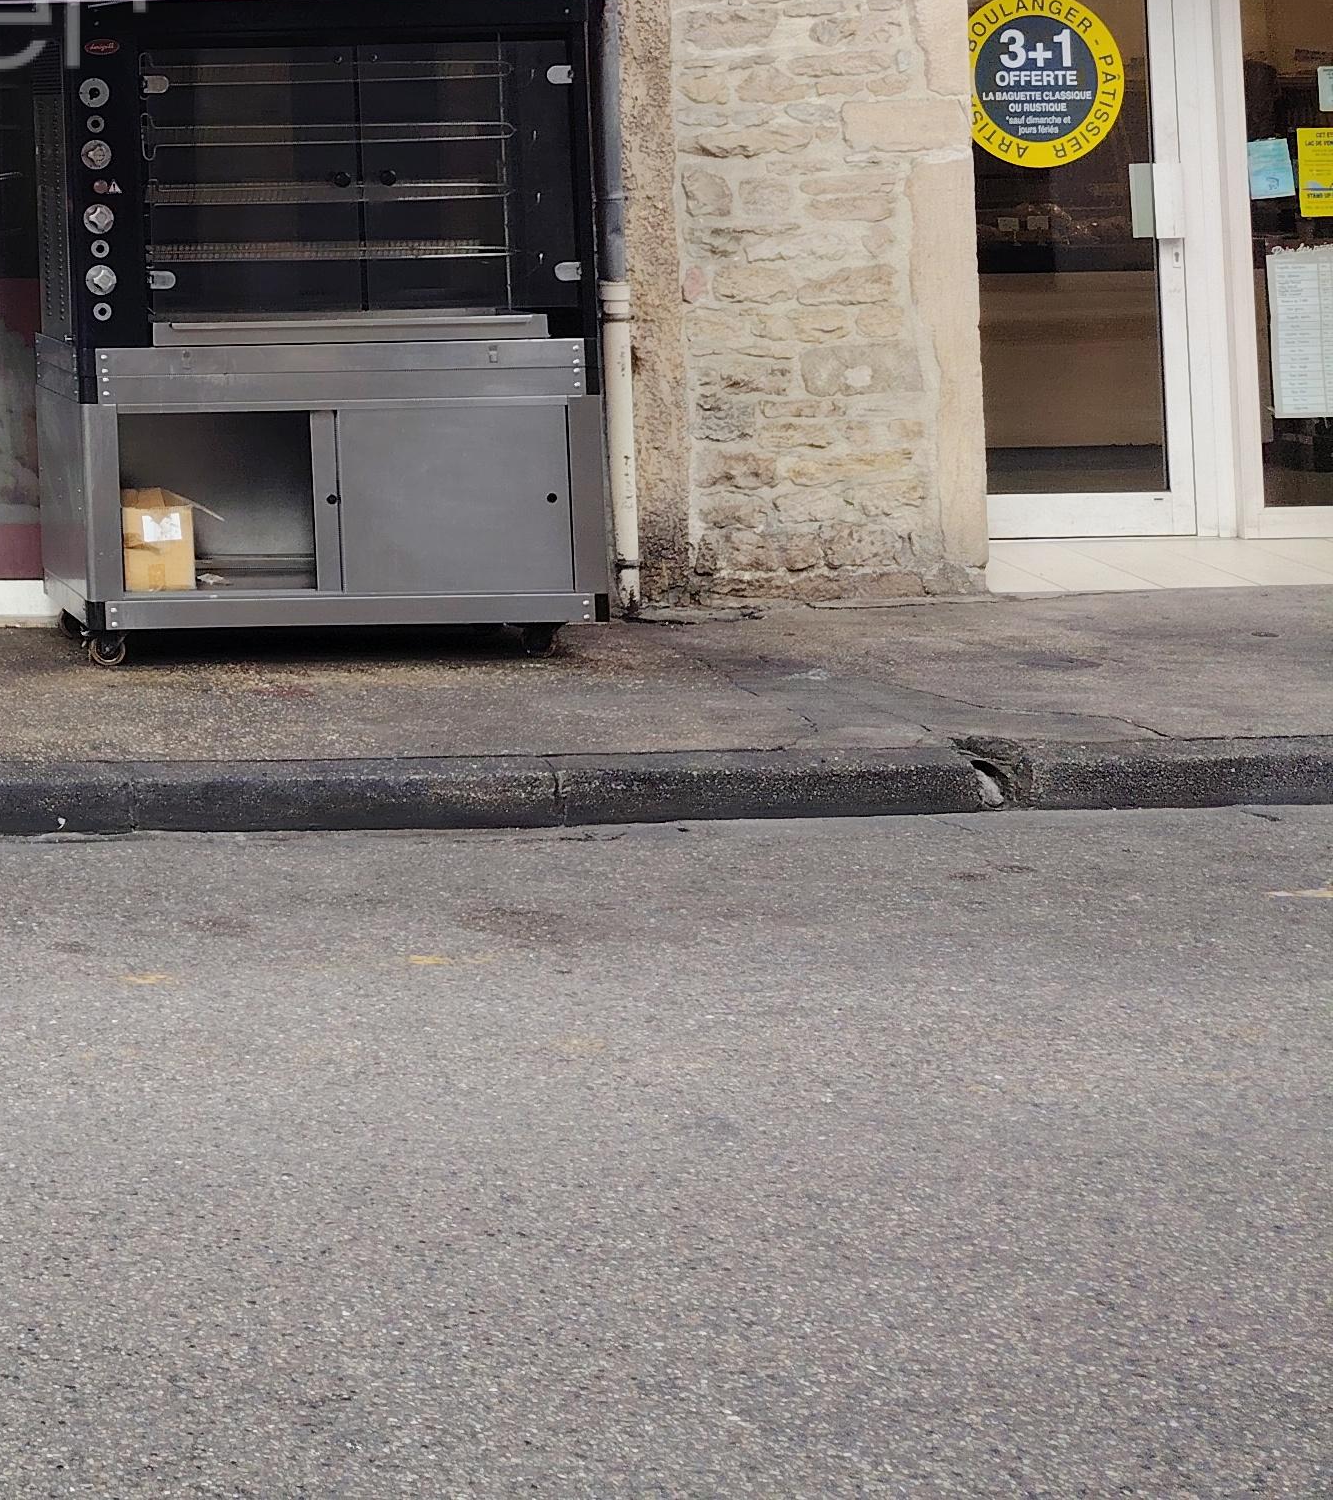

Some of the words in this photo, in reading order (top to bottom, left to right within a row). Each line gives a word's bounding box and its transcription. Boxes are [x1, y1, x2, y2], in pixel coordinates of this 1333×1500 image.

[999, 28, 1072, 68] 3+1
[995, 70, 1078, 87] OFFERTE
[983, 92, 995, 101] LA
[996, 91, 1042, 101] BAGUETTE
[1043, 91, 1092, 100] CLASSIQUE
[1009, 103, 1022, 112] OU
[1023, 103, 1067, 112] RUSTIQUE
[1026, 116, 1062, 124] dimanche
[1063, 116, 1071, 124] et
[1018, 126, 1037, 135] jours
